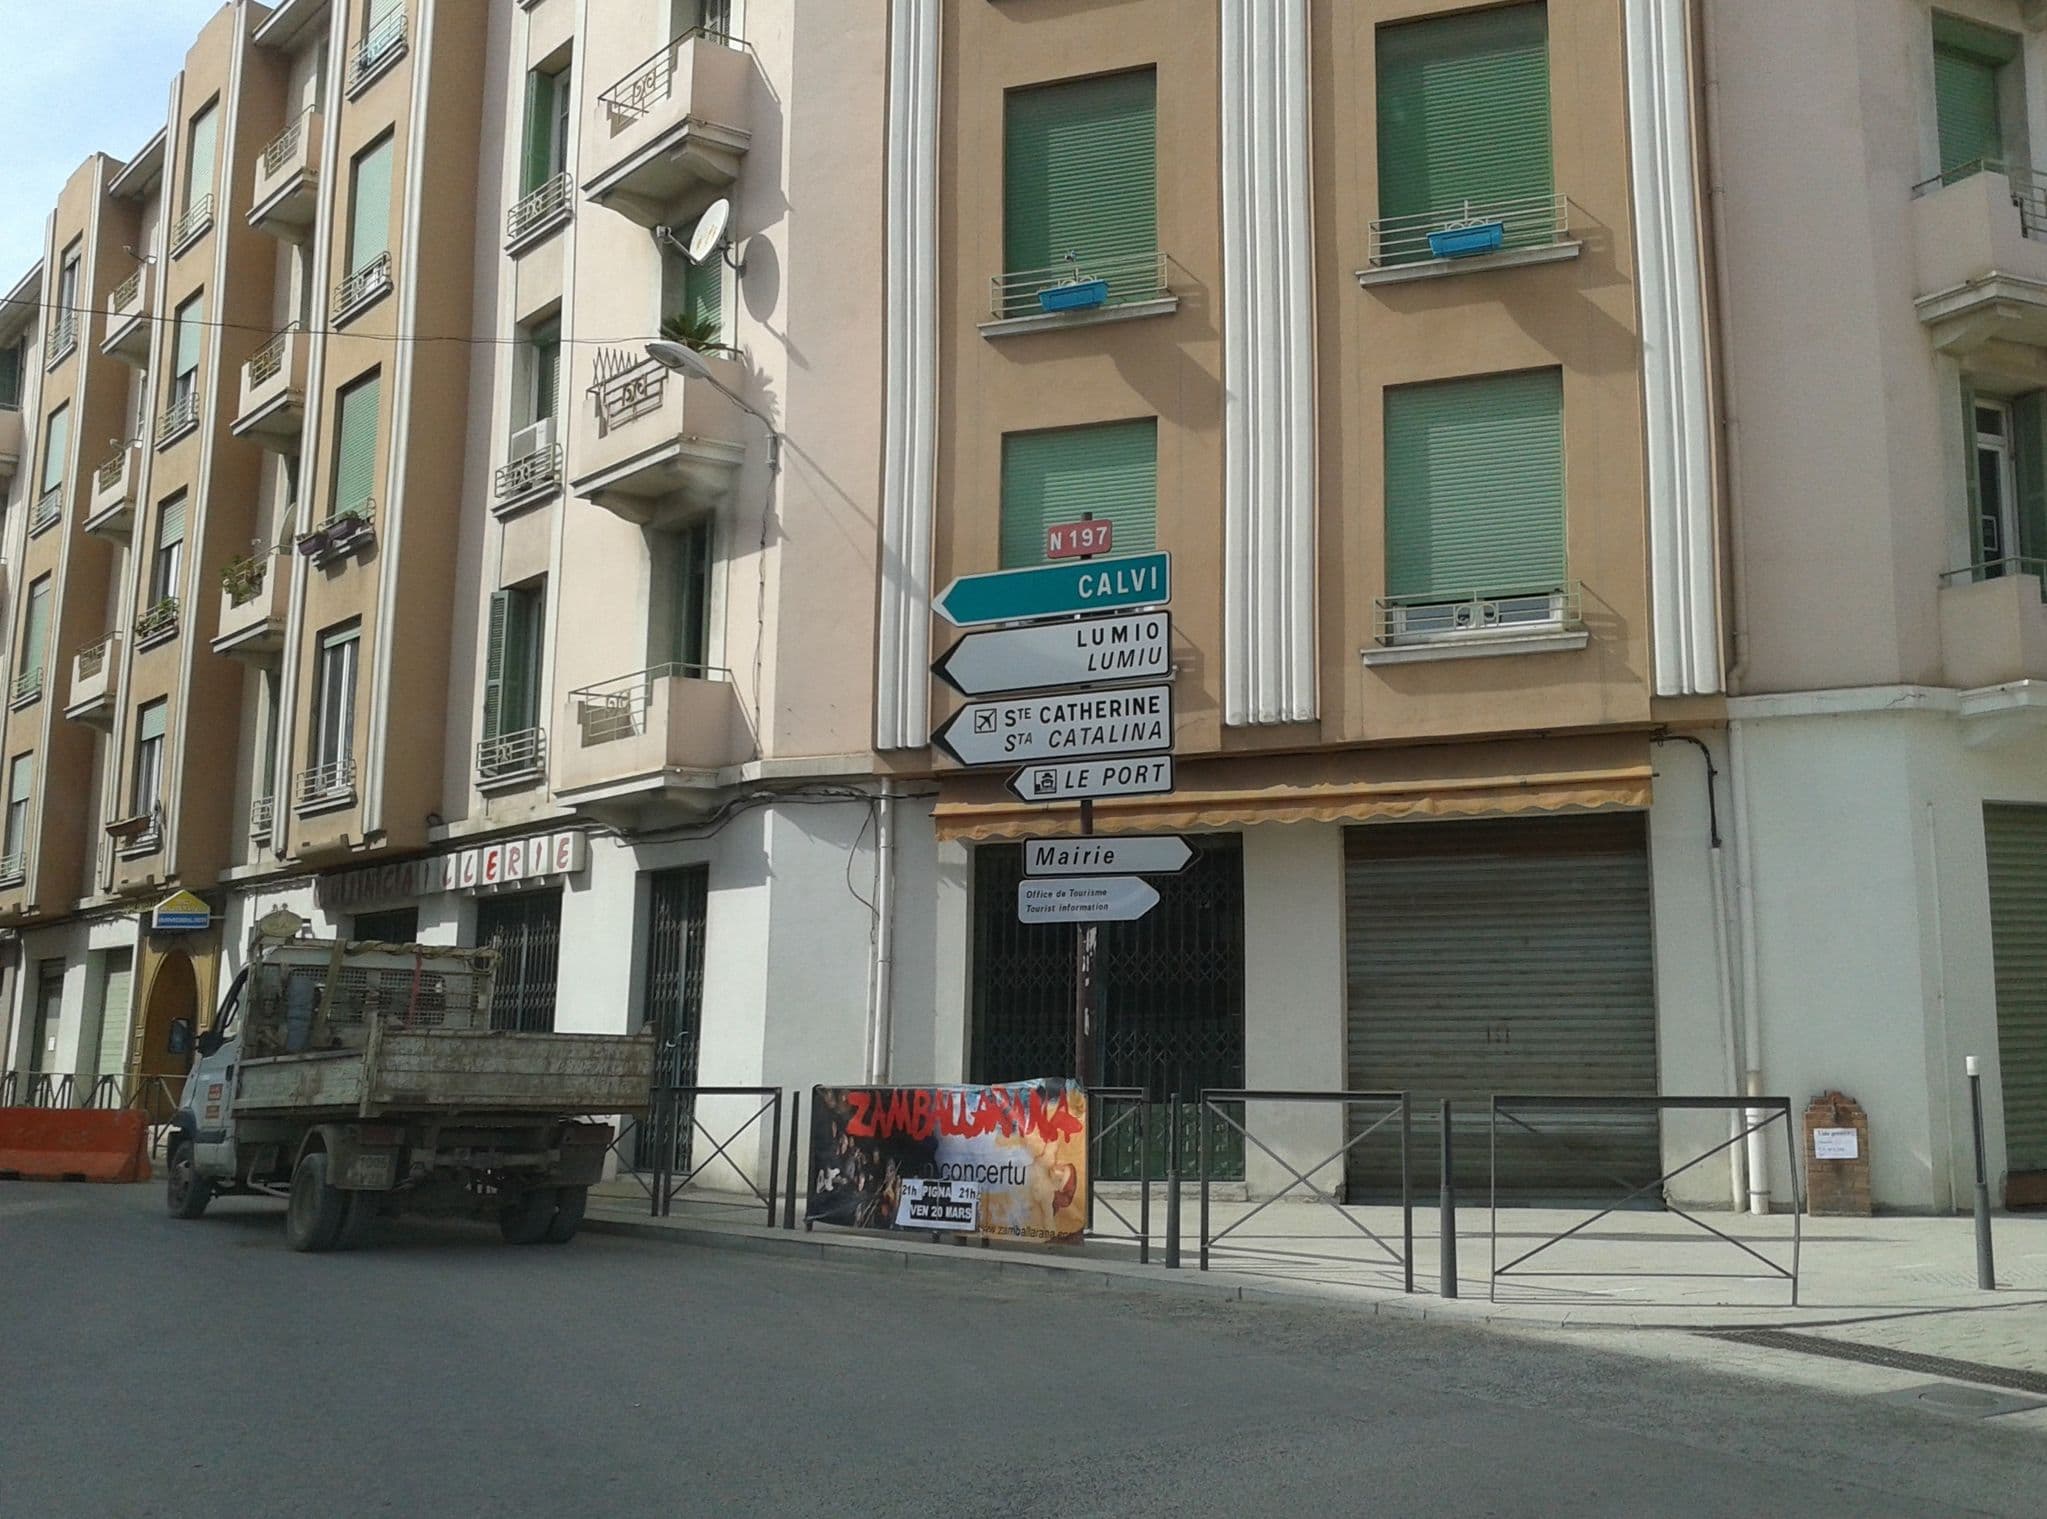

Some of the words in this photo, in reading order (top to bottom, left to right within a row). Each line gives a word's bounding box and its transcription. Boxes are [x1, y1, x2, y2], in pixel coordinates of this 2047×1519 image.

[1050, 531, 1062, 551] N
[1069, 526, 1108, 549] 197
[1078, 565, 1157, 599] CALVI
[1077, 621, 1159, 648] LUMIO
[1087, 646, 1163, 672] LUMIU
[1039, 695, 1161, 724] CATHERINE
[1048, 720, 1162, 749] CATALINA
[1064, 769, 1090, 790] LE
[1102, 763, 1165, 787] PORT
[1035, 845, 1115, 867] Mairie
[1026, 889, 1053, 899] Office
[1056, 889, 1066, 899] de
[1069, 888, 1108, 898] Tourisme
[1026, 904, 1056, 913] Tourist
[940, 1160, 1027, 1185] concertu
[902, 1184, 917, 1196] 21h
[959, 1187, 976, 1199] 21h
[911, 1204, 929, 1217] VEN
[931, 1205, 943, 1217] 20
[945, 1206, 972, 1219] MARS
